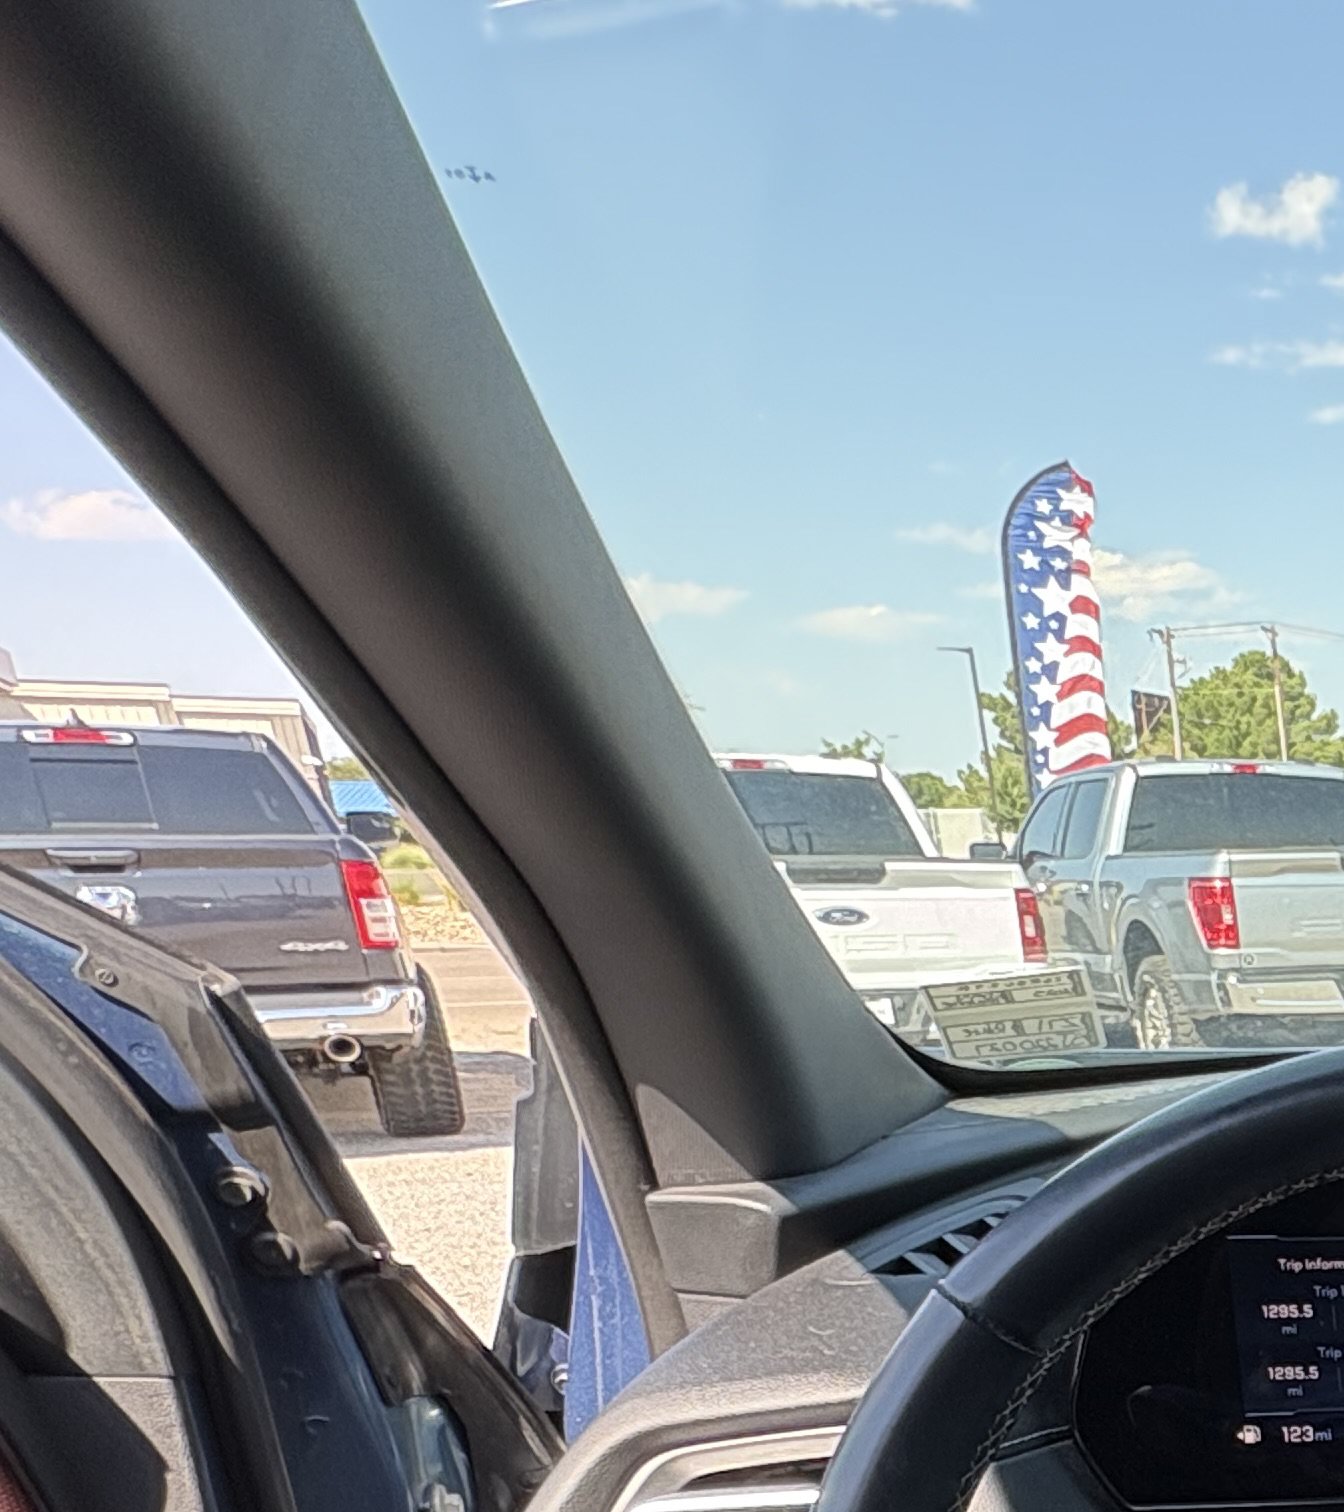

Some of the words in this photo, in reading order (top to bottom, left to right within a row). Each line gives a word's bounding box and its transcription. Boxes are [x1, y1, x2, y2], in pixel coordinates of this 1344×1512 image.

[1278, 1258, 1302, 1273] Trip
[1313, 1285, 1336, 1300] Trip
[1261, 1304, 1314, 1320] 1295.5
[1281, 1323, 1298, 1335] mi
[1317, 1346, 1342, 1361] Trip
[1287, 1385, 1303, 1397] mi
